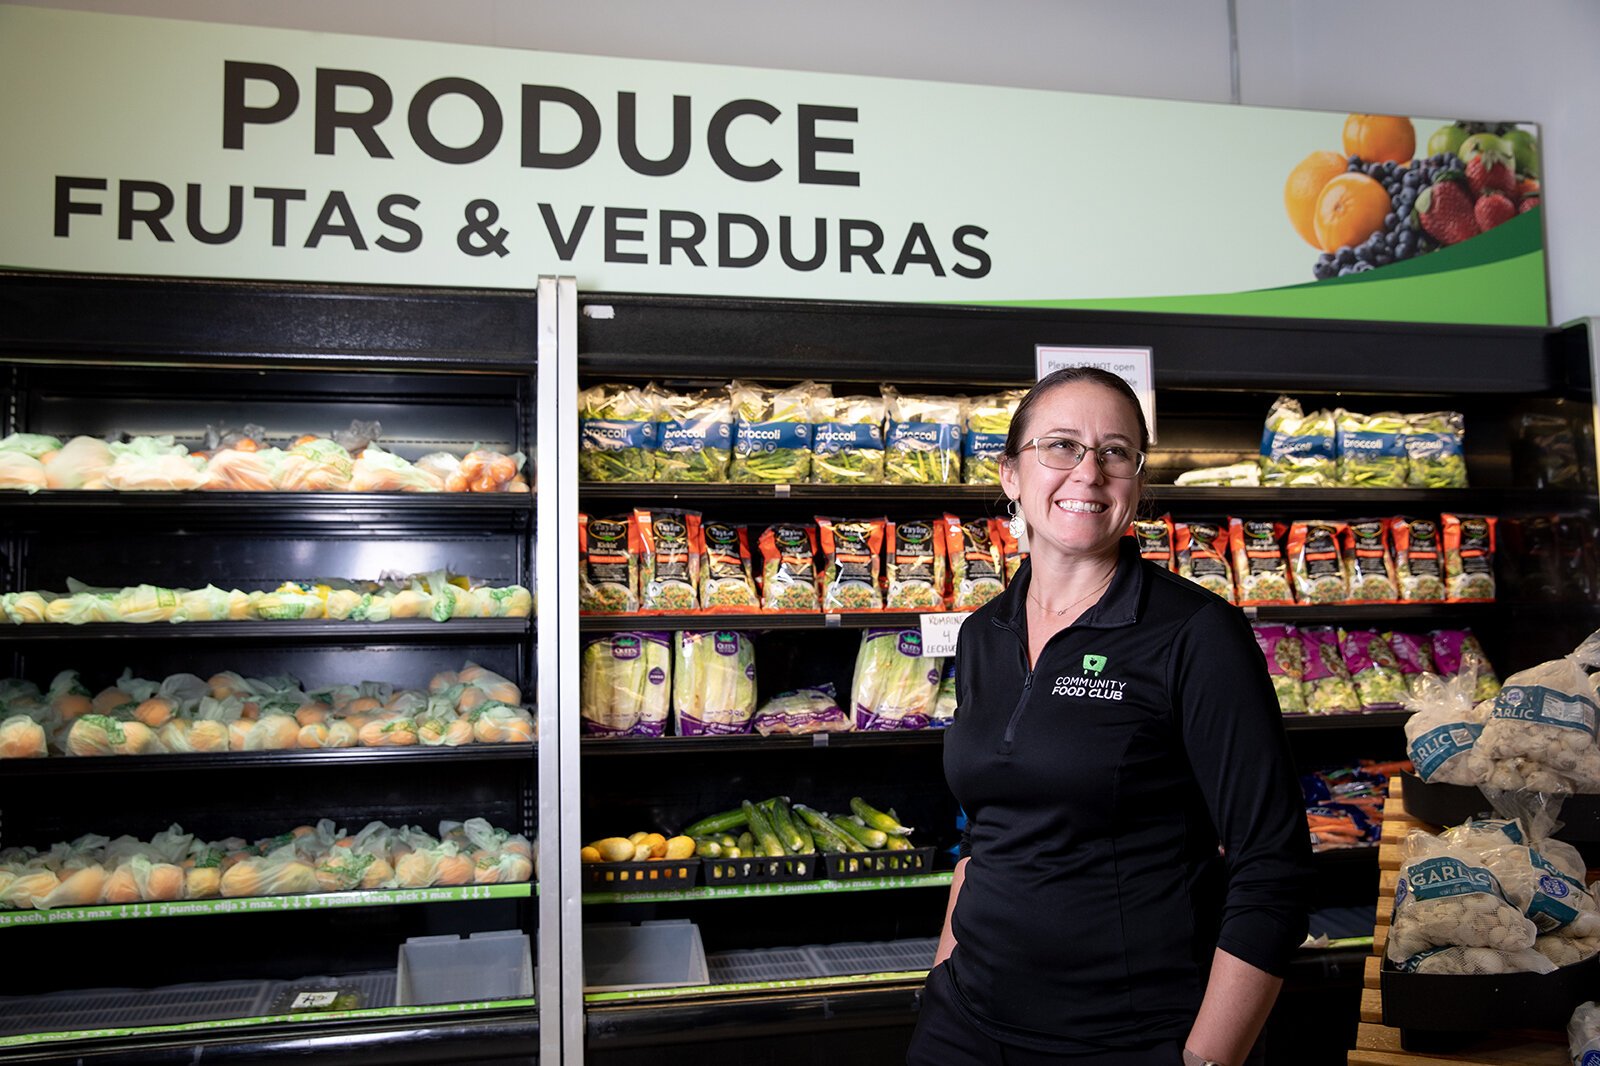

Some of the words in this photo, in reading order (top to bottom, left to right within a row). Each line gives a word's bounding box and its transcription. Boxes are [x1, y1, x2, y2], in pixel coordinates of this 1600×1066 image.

[223, 60, 860, 187] PRODUCE
[54, 176, 422, 253] FRUTAS
[457, 199, 509, 257] &
[537, 203, 992, 279] VERDURAS
[1047, 360, 1075, 371] Please
[1113, 363, 1136, 373] open
[664, 428, 707, 439] broccoli
[737, 428, 781, 440] broccoli
[815, 430, 857, 442] broccoli
[895, 428, 938, 442] broccoli
[974, 440, 1007, 451] brocc
[1343, 438, 1384, 450] broccoli
[902, 525, 928, 535] Taylor
[942, 630, 951, 643] 4
[1055, 676, 1127, 691] COMMUNITY
[1051, 686, 1086, 697] FOOD
[1087, 688, 1123, 701] CLUB
[1410, 865, 1491, 887] GARLIC
[623, 891, 655, 902] points
[657, 889, 684, 899] each,
[685, 887, 707, 898] pick
[708, 886, 715, 896] 3
[717, 886, 739, 895] max
[777, 884, 784, 892] 2
[785, 882, 822, 894] puntos,
[823, 879, 843, 891] elija
[852, 879, 876, 888] max.
[14, 912, 46, 923] each,
[48, 909, 75, 923] pick
[77, 910, 85, 919] 3
[87, 909, 113, 919] max
[160, 905, 167, 914] 2
[168, 903, 212, 916] puntos,
[214, 900, 238, 912] elija
[240, 901, 247, 910] 3
[249, 900, 277, 909] max.
[319, 896, 326, 905] 2
[327, 895, 362, 907] points
[364, 893, 394, 903] each,
[395, 891, 419, 903] pick
[421, 891, 428, 900] 3
[430, 890, 453, 899] max
